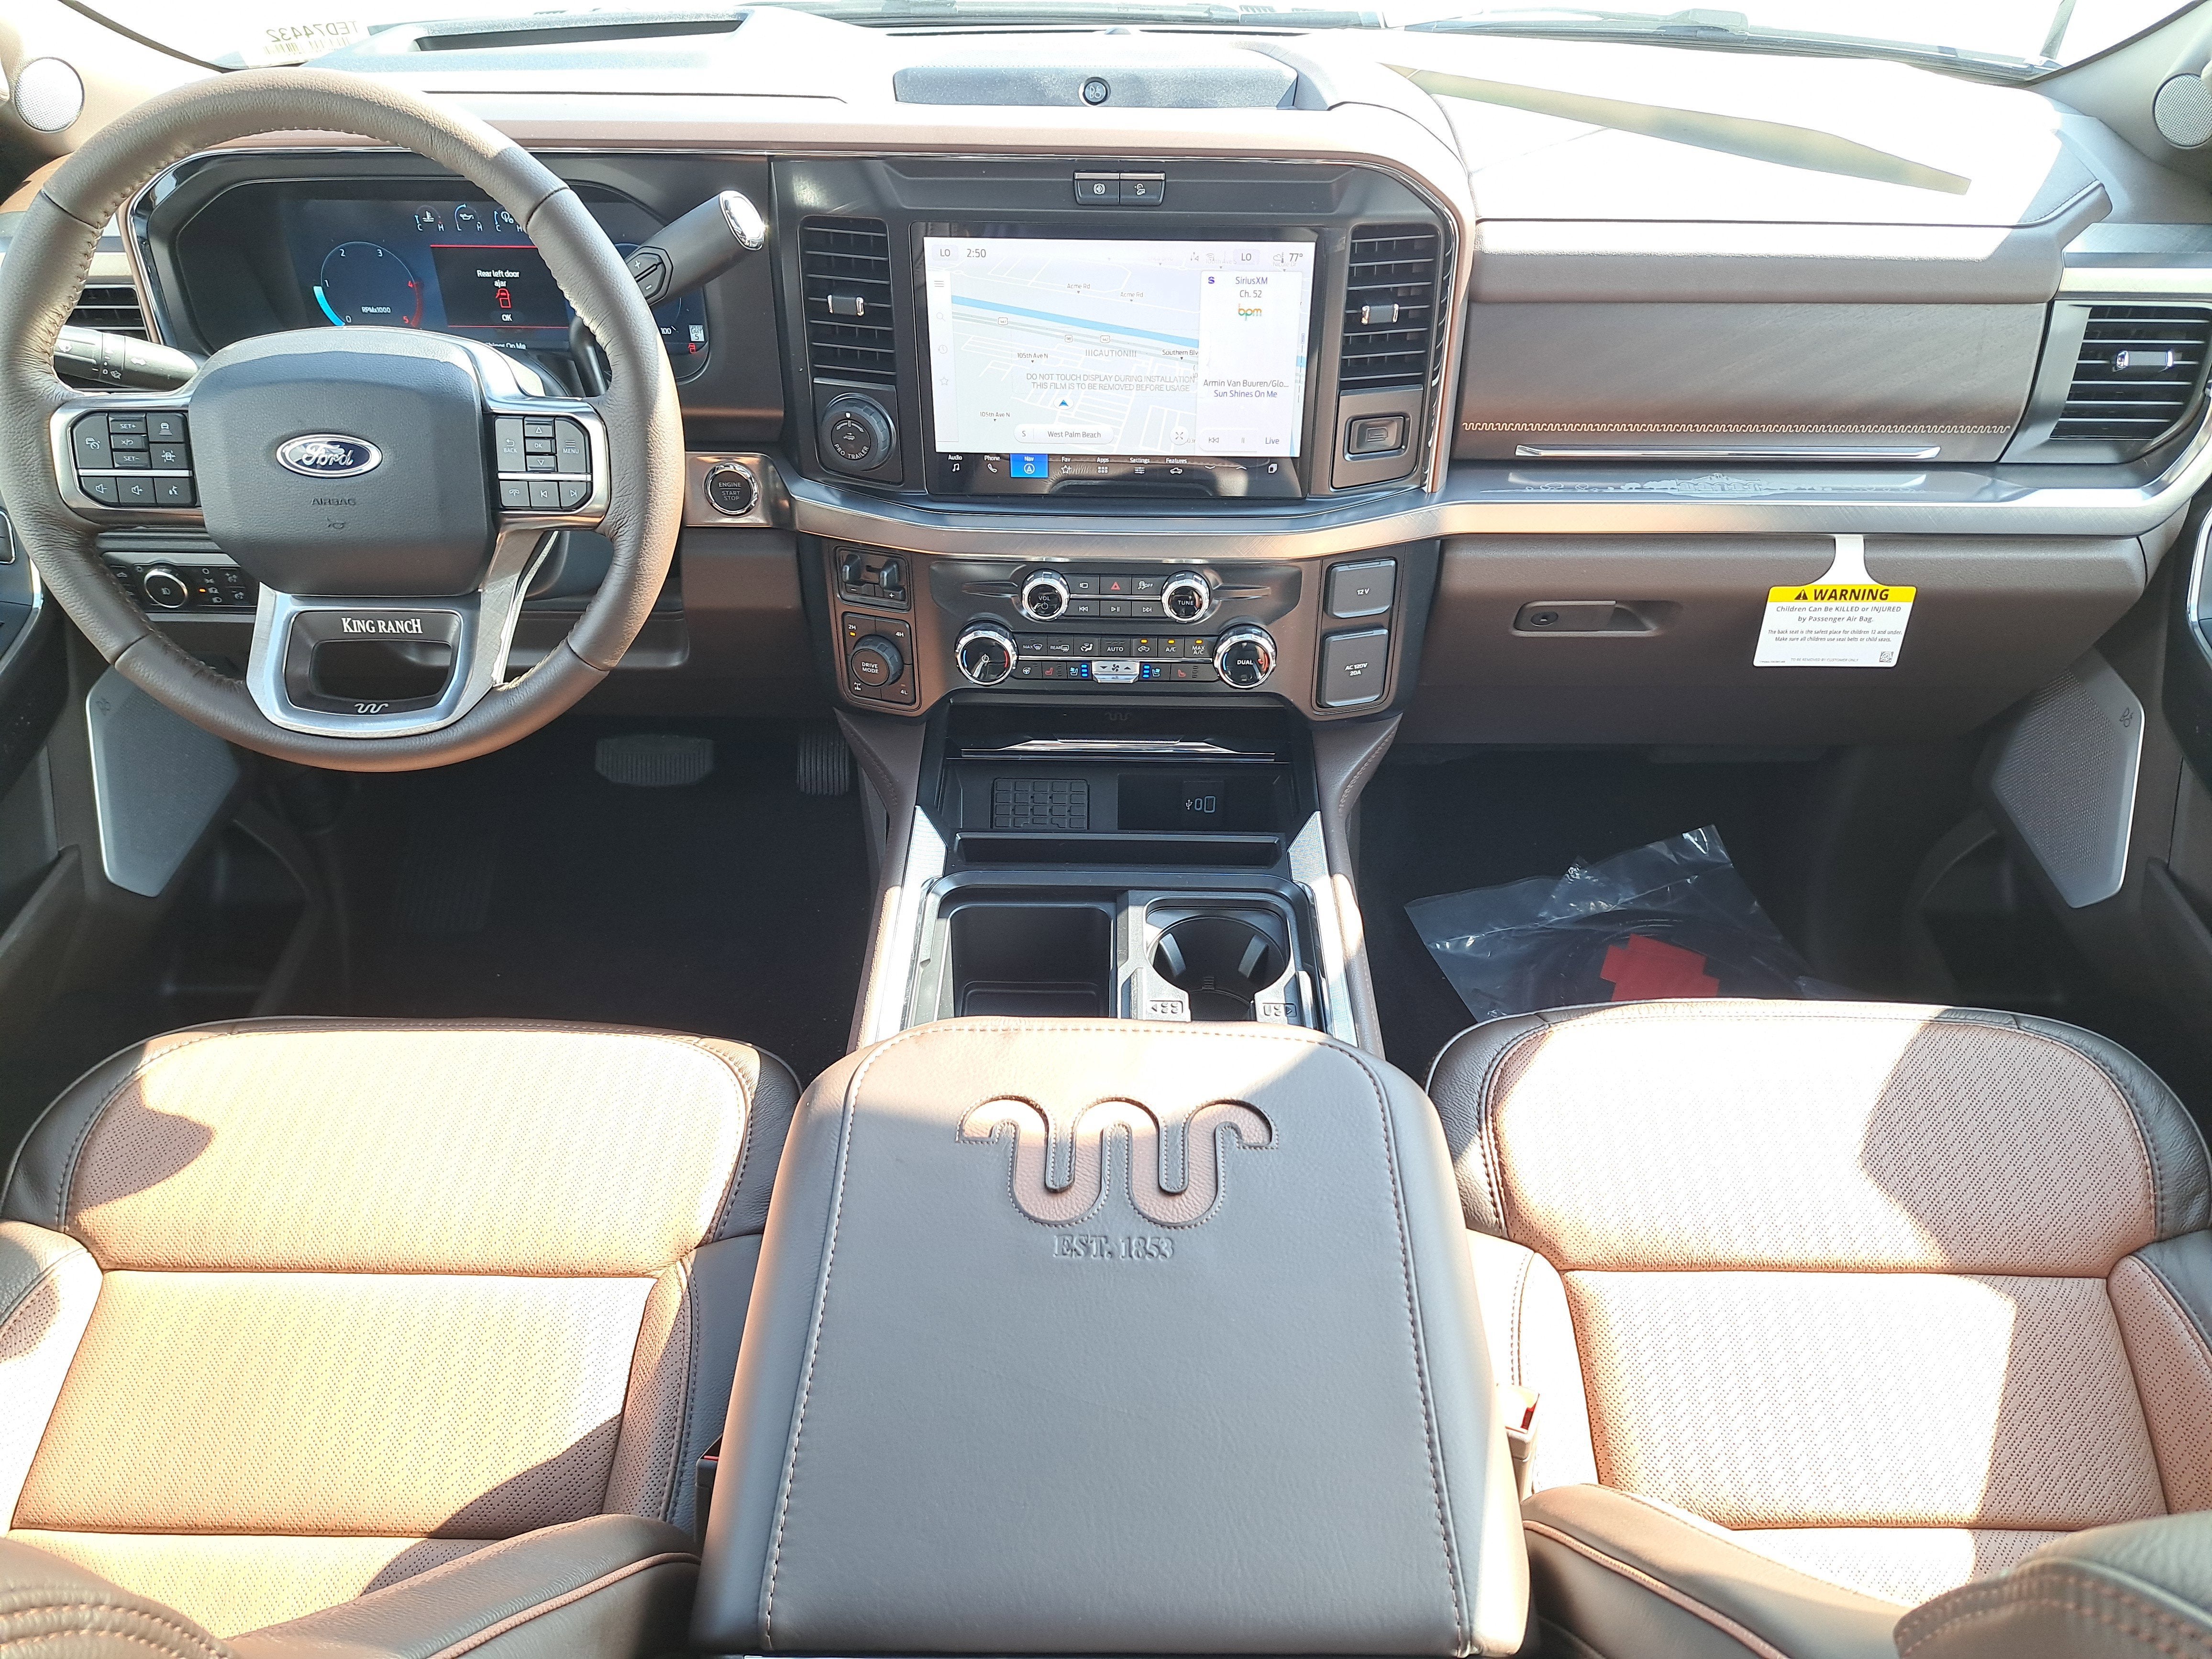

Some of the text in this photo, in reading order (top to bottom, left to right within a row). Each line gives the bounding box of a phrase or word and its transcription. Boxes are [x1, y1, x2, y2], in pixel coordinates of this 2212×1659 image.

[339, 249, 345, 257] 2
[377, 249, 383, 257] 3
[940, 249, 951, 257] LO
[967, 249, 986, 257] 2:50
[1289, 253, 1303, 262] 77°
[494, 279, 507, 288] ajar
[1238, 304, 1262, 321] bpm
[302, 443, 354, 466] Ford
[834, 444, 869, 459] PRO TRAILER
[1814, 589, 1890, 601] WARNING
[342, 618, 423, 634] KING RANCH
[1053, 1235, 1174, 1261] EST. 1853
